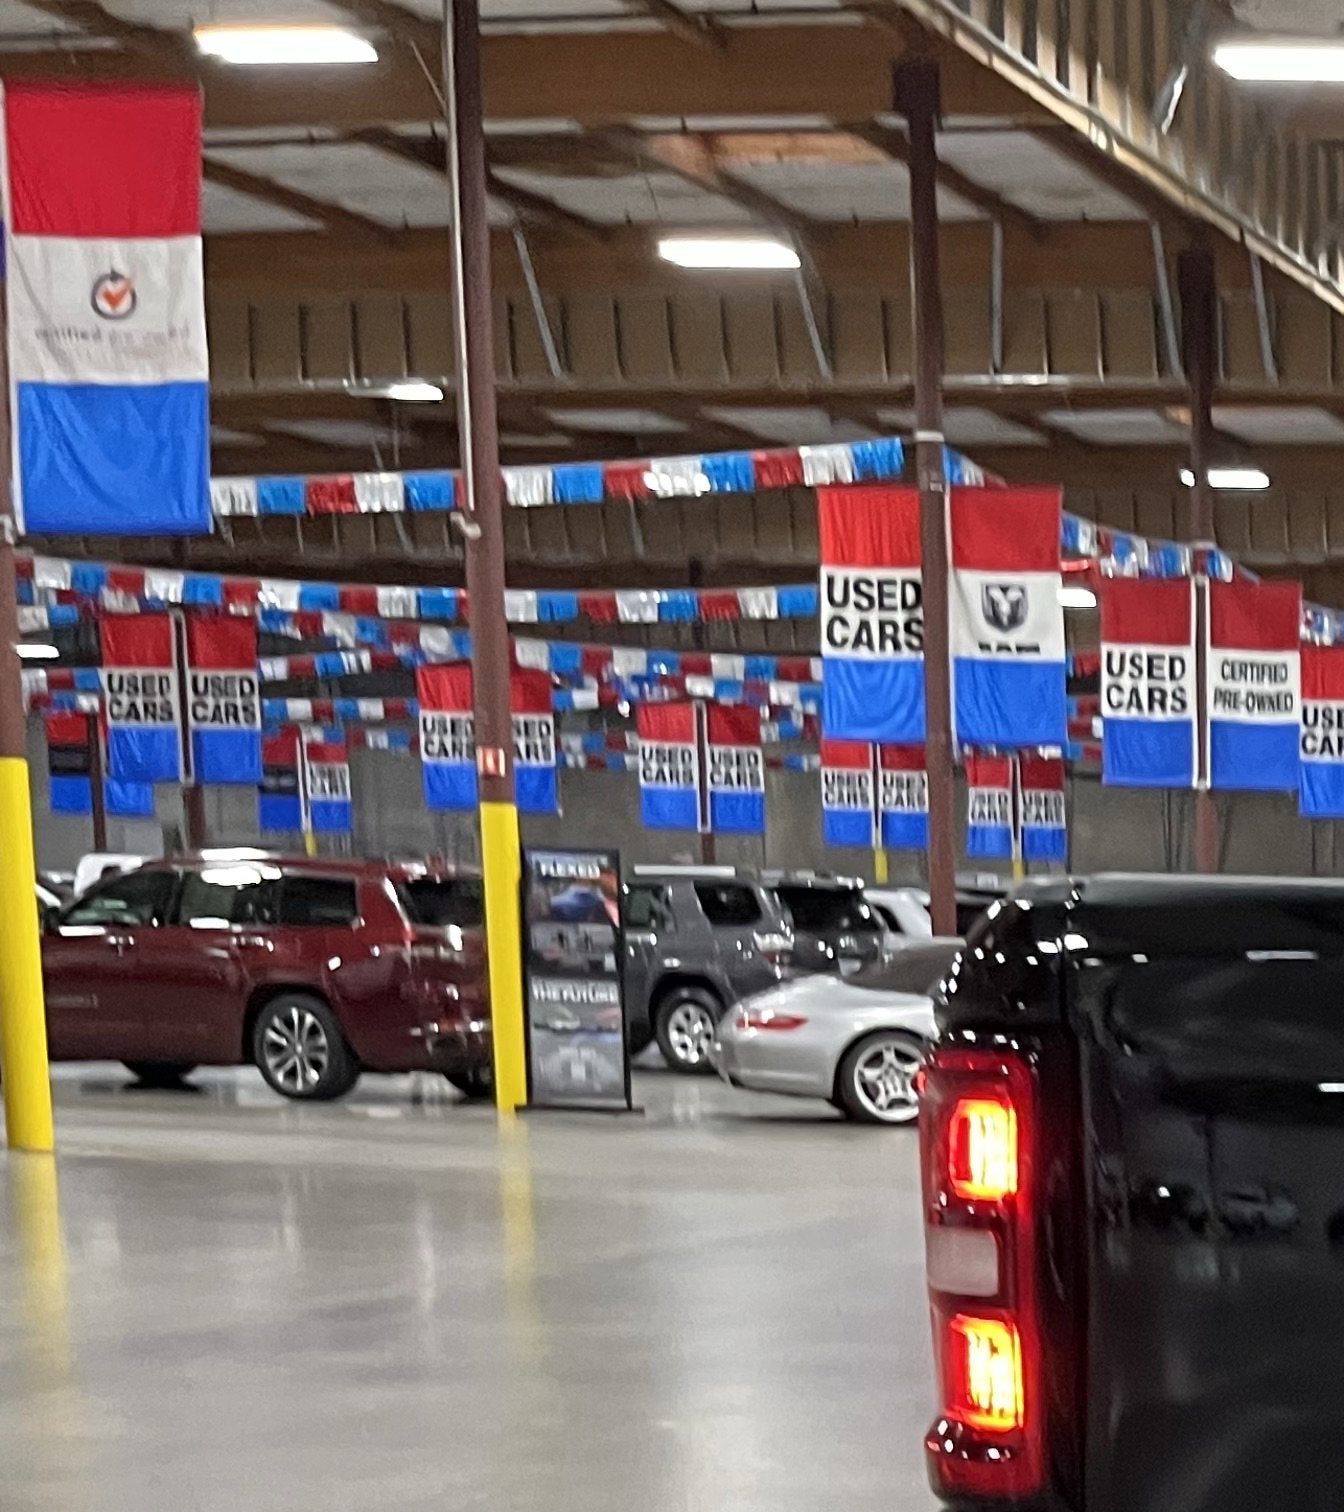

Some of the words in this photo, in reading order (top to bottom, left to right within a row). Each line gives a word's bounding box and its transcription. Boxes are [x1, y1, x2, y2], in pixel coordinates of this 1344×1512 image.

[827, 574, 923, 612] USED
[826, 615, 924, 653] CARS
[1106, 651, 1186, 681] USED
[1221, 658, 1288, 684] CERTIFIED
[107, 673, 171, 697] USED
[191, 675, 256, 699] USED
[1106, 683, 1187, 713] CARS
[109, 697, 174, 722] CARS
[191, 700, 257, 724] CARS
[1213, 686, 1294, 713] PRE-OWNED
